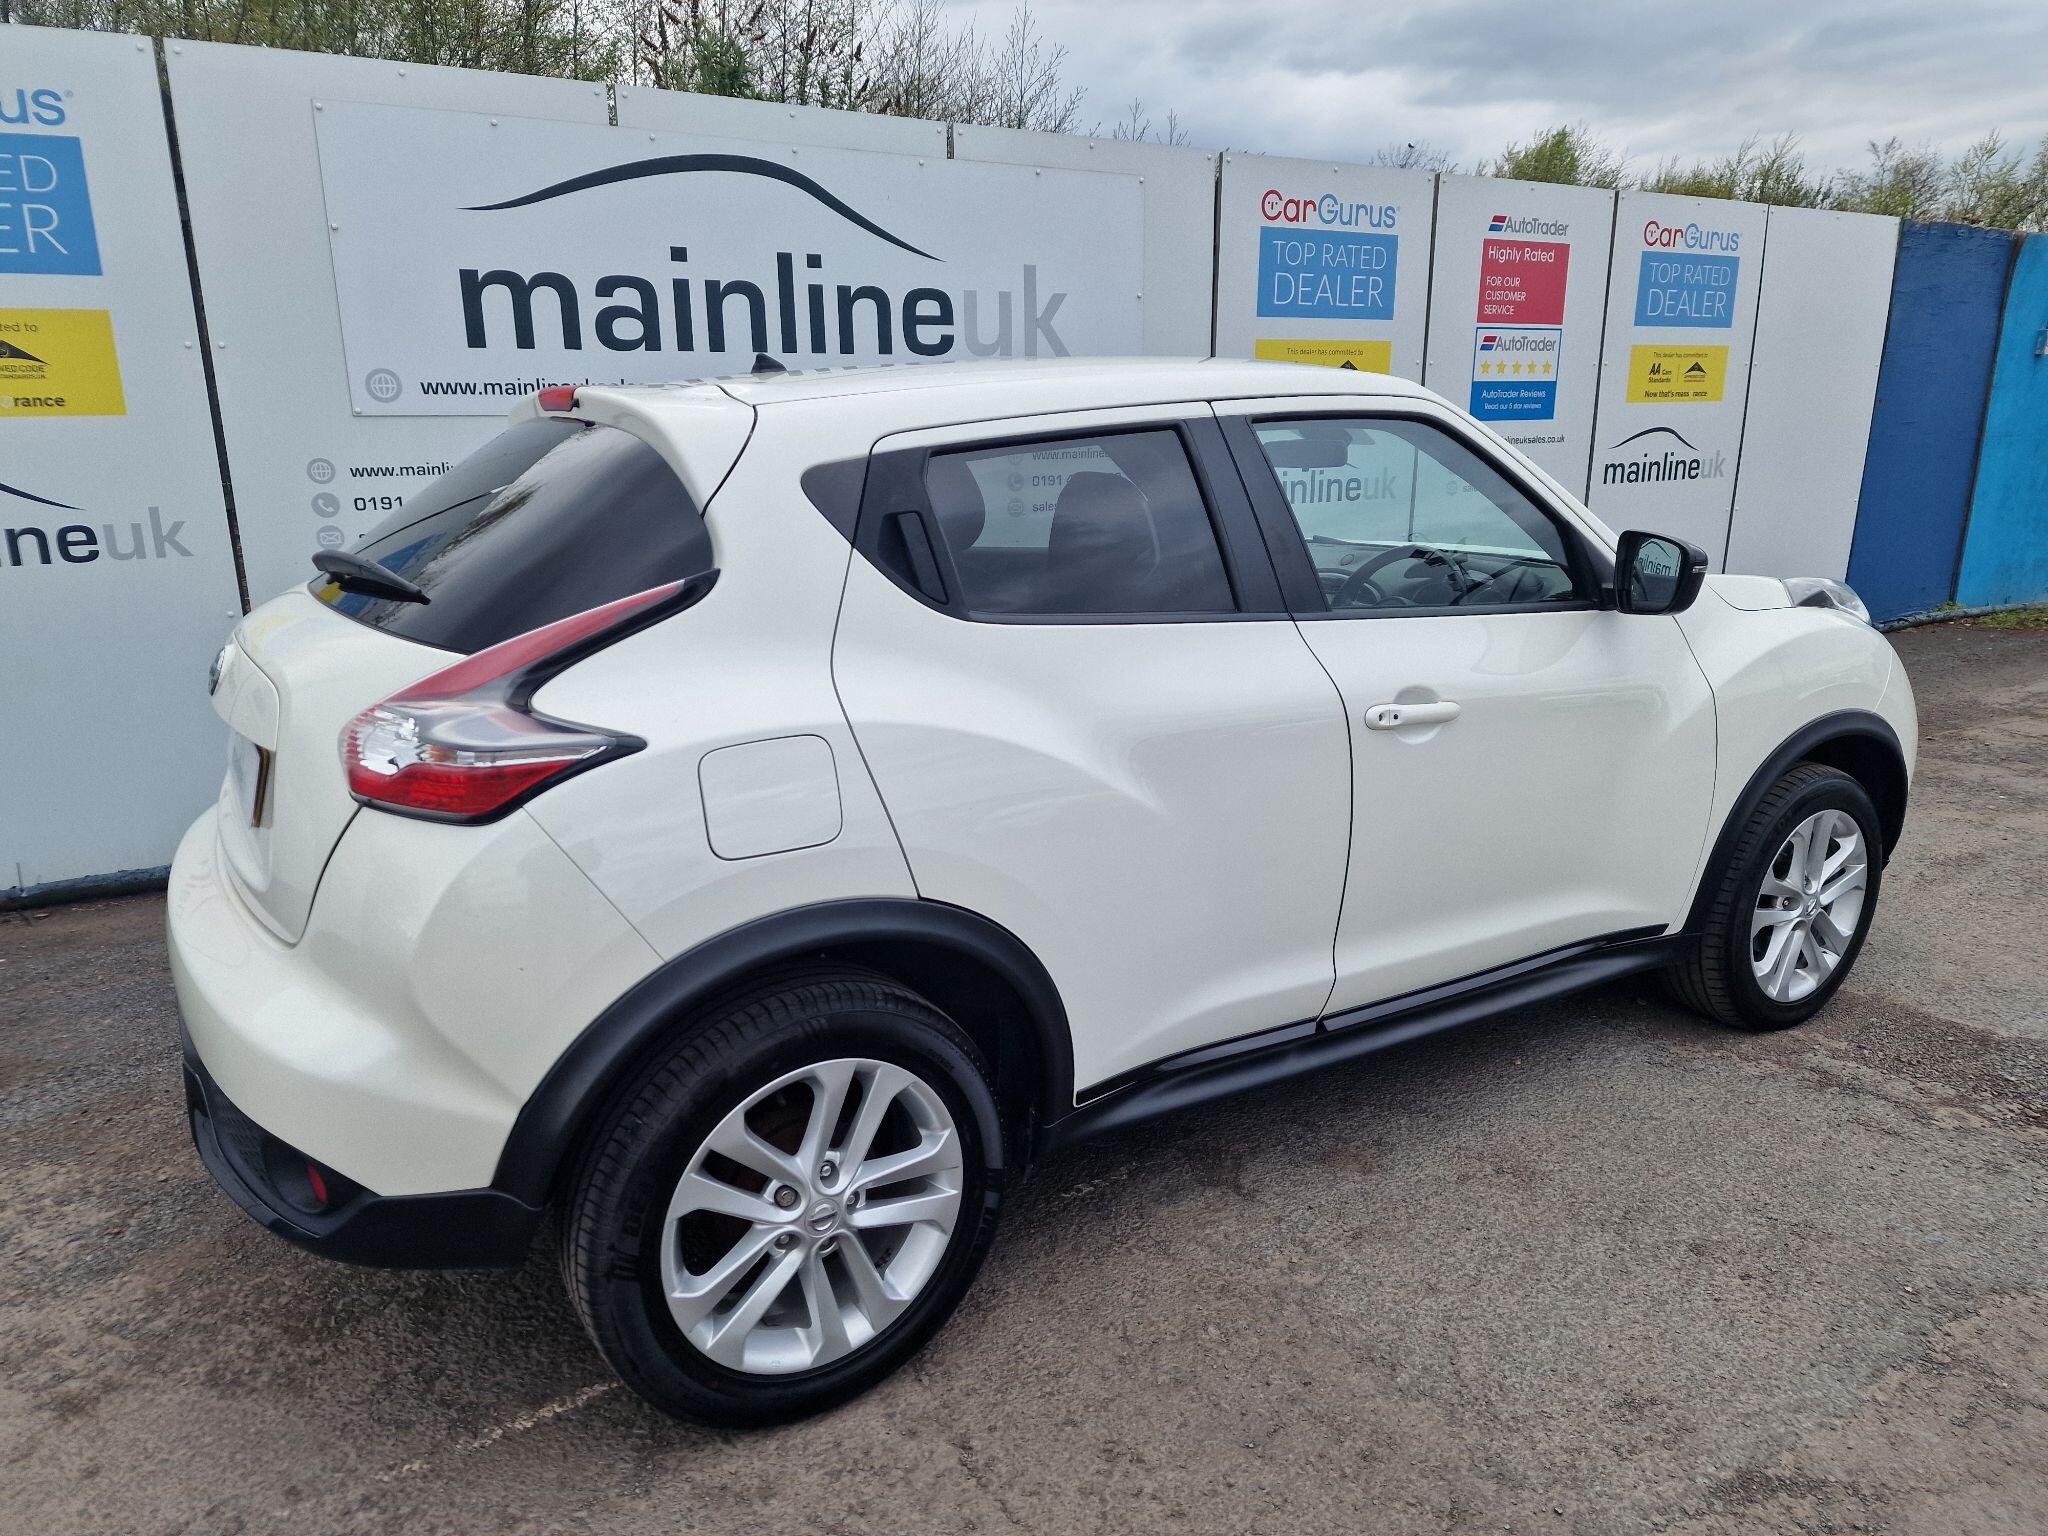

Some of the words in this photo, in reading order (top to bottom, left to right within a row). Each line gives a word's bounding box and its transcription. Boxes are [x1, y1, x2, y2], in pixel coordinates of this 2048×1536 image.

[1261, 189, 1396, 228] CarGurus
[1504, 217, 1569, 236] AutoTrader
[1644, 220, 1739, 251] CarGurus
[1273, 240, 1316, 266] TOP
[1322, 244, 1387, 270] RATED
[1488, 246, 1521, 263] Highly
[1524, 248, 1555, 262] Rated
[1486, 276, 1502, 286] FOR
[1504, 277, 1520, 287] OUR
[1649, 262, 1680, 283] TOP
[1683, 264, 1731, 286] RATED
[1274, 272, 1383, 308] DEALER
[1485, 290, 1526, 301] CUSTOMER
[459, 246, 1070, 360] mainlineuk
[1484, 305, 1514, 315] SERVICE
[1647, 289, 1727, 317] DEALER
[1495, 336, 1557, 352] AutoTrader
[1649, 363, 1661, 375] AA
[1482, 389, 1519, 398] AutoTrader
[1520, 389, 1546, 398] Reviews
[1603, 450, 1726, 485] mainlineuk
[1033, 474, 1062, 487] 0191
[354, 496, 403, 511] 0191
